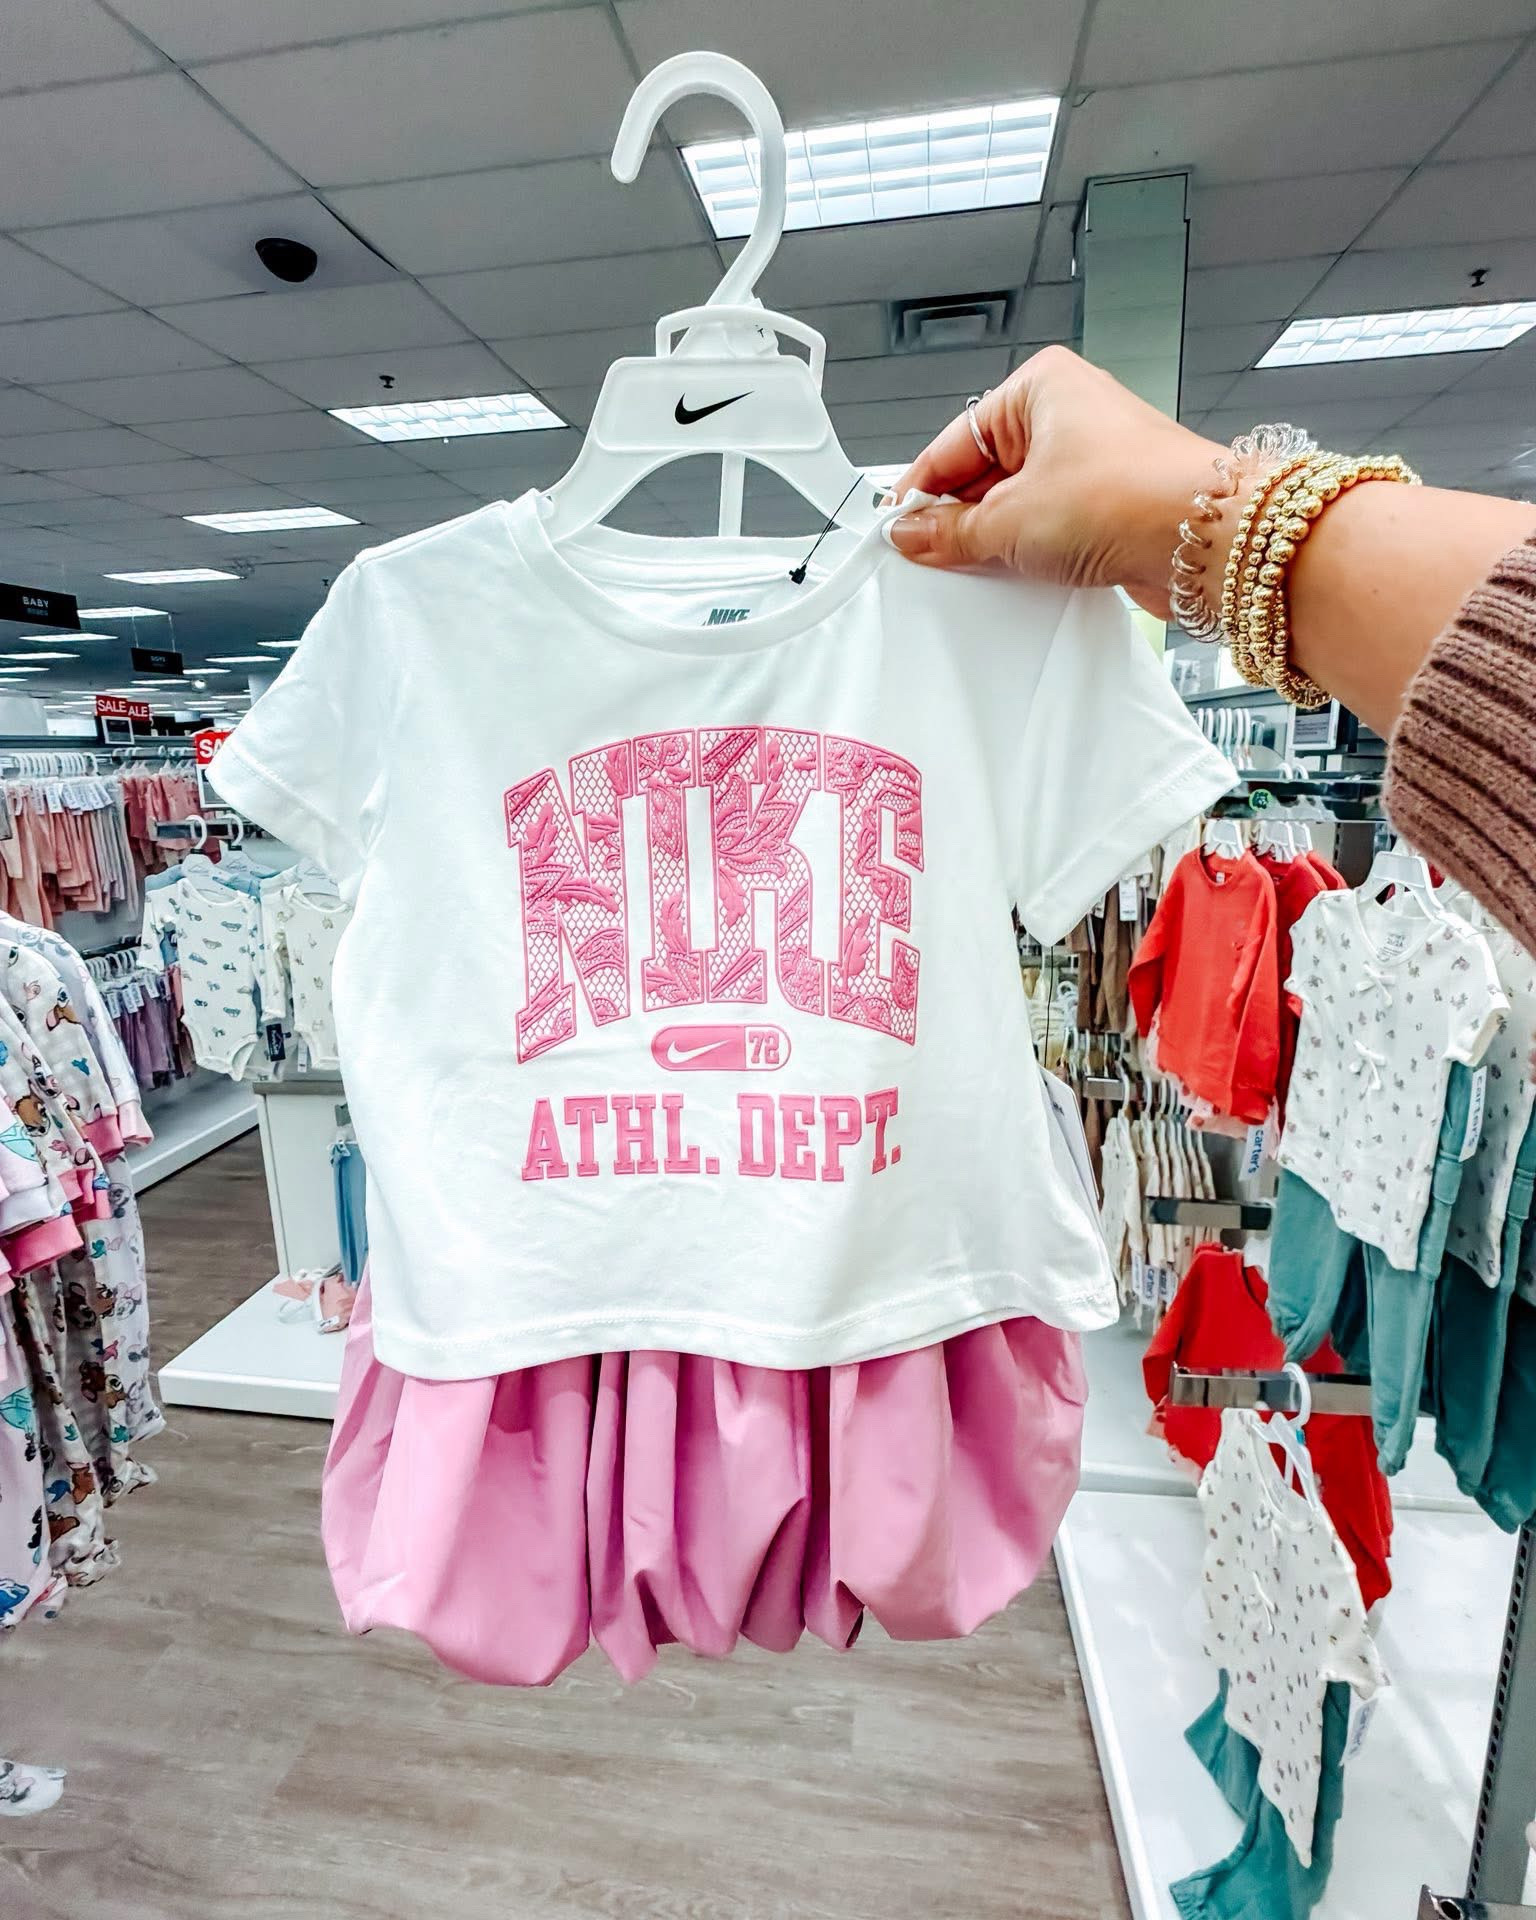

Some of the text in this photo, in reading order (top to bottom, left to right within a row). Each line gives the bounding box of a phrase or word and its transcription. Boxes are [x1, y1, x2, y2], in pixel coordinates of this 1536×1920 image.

[22, 596, 49, 608] BABY
[706, 608, 751, 626] NIKE
[97, 700, 127, 713] SALE
[127, 706, 148, 717] ALE
[199, 738, 223, 759] SA
[503, 725, 925, 1065] NIKE
[748, 1030, 782, 1065] 72
[1467, 1075, 1483, 1147] carter's
[521, 1086, 902, 1182] ATHL. DEPT.
[1247, 1129, 1264, 1174] carter's
